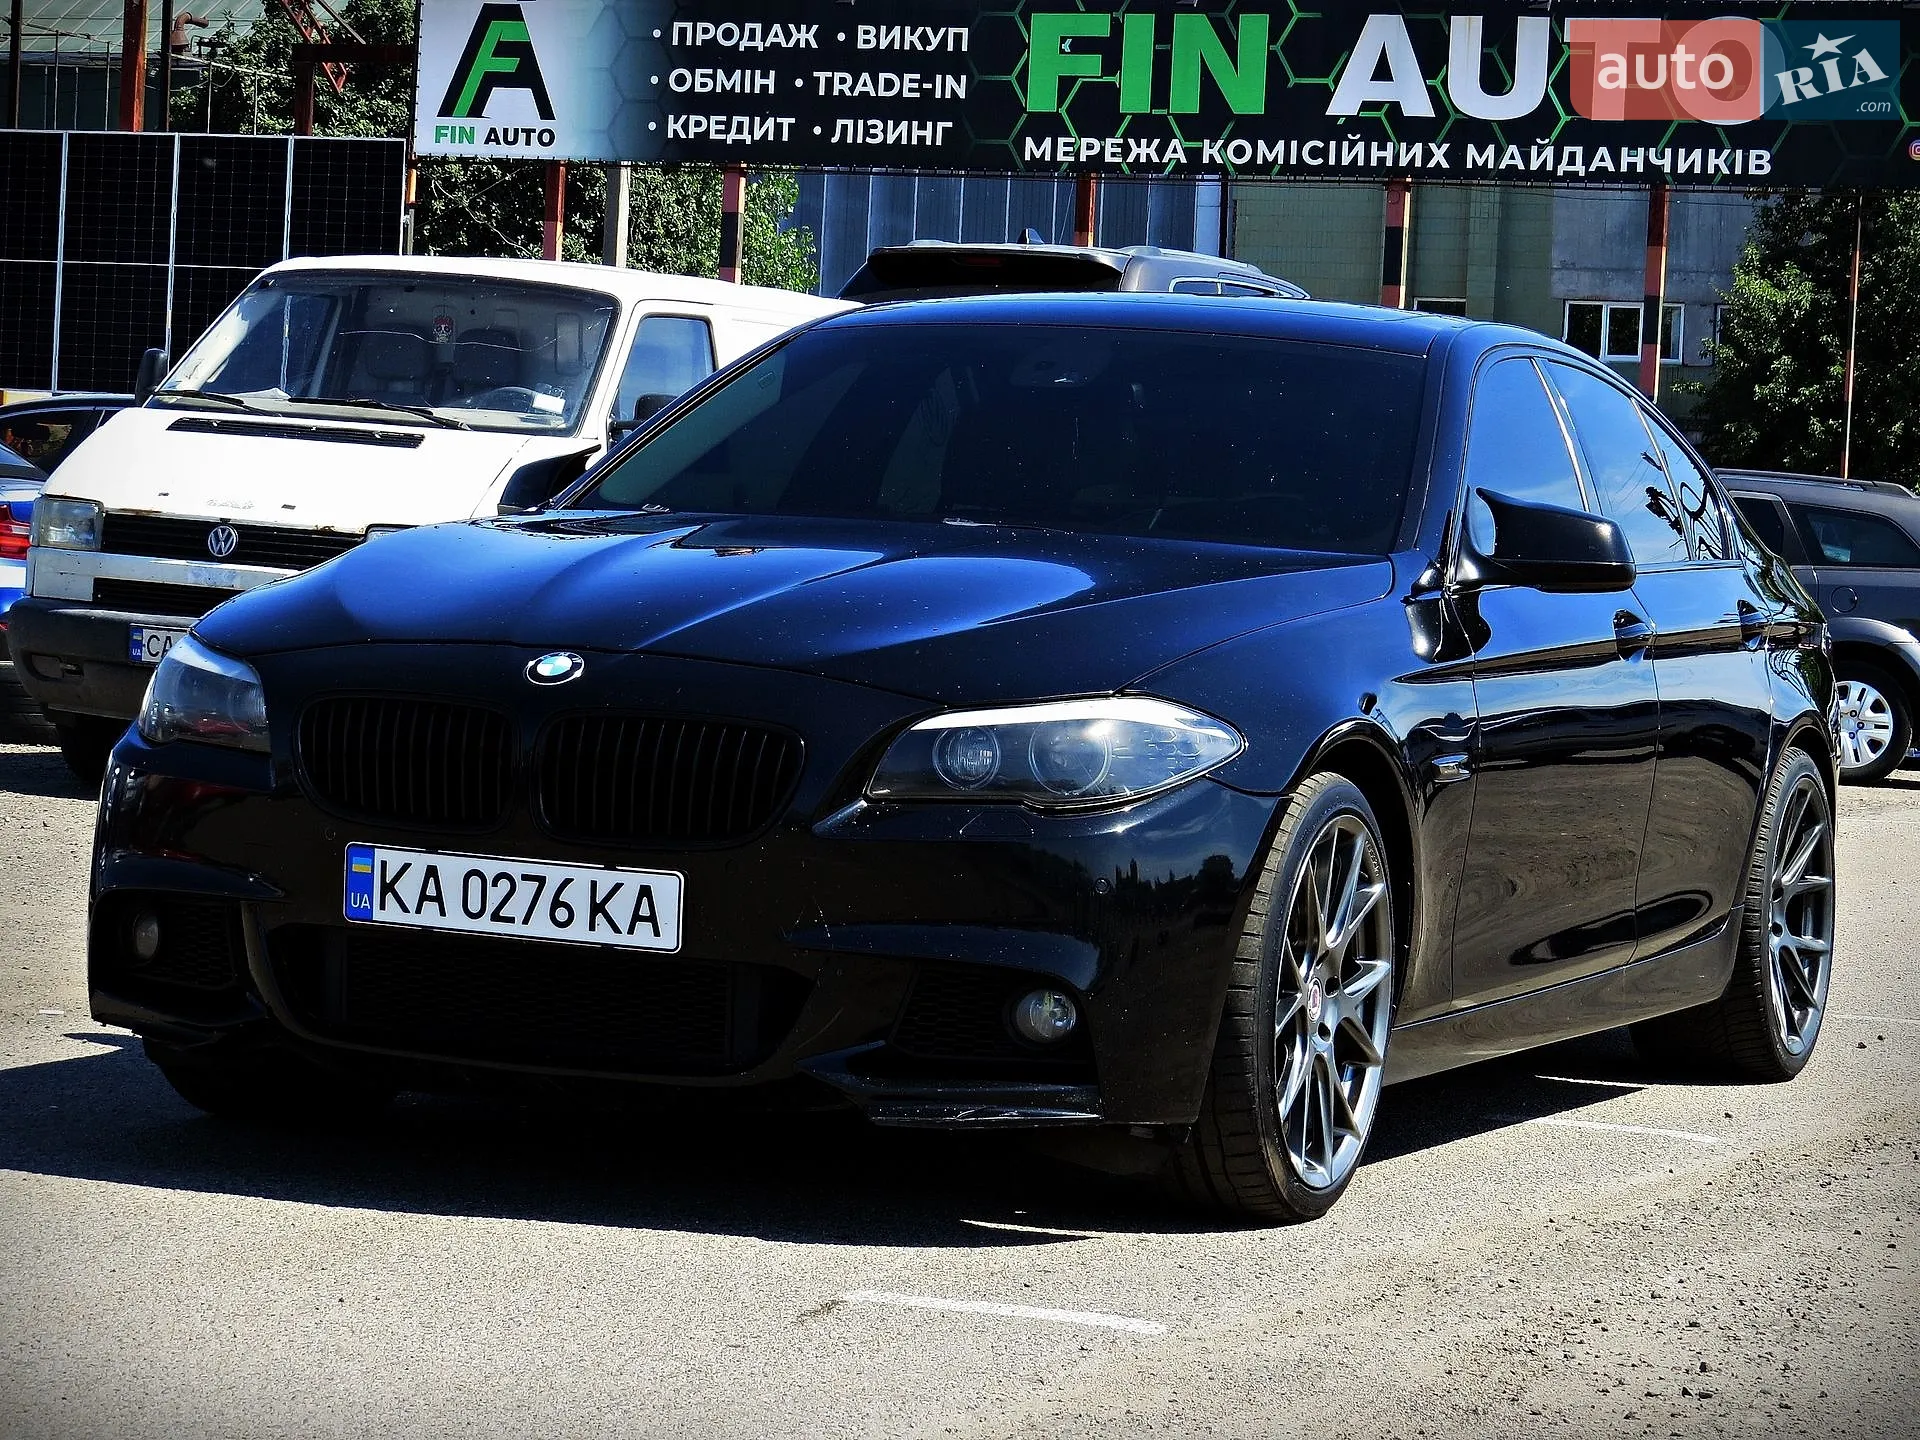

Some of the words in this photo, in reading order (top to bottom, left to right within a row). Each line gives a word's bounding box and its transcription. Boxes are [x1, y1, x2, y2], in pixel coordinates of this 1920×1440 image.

[671, 22, 818, 52] ПРОДАЖ
[857, 25, 969, 53] ВИКУП
[669, 68, 775, 95] ОБМІН
[813, 71, 967, 99] TRADE-IN
[1027, 13, 1269, 114] FIN
[1324, 14, 1786, 126] AUTO
[434, 125, 475, 144] FIN
[484, 127, 556, 147] AUTO
[667, 115, 795, 144] КРЕДИТ
[830, 119, 953, 146] ЛІЗИНГ
[1024, 136, 1188, 165] МЕРЕЖА
[1202, 134, 1450, 168] КОМІСІЙНИХ
[1466, 138, 1772, 176] МАЙДАНЧИКІВ
[351, 891, 371, 910] UA
[379, 859, 448, 918] KA
[461, 868, 576, 930] 0276
[588, 879, 662, 938] KA
